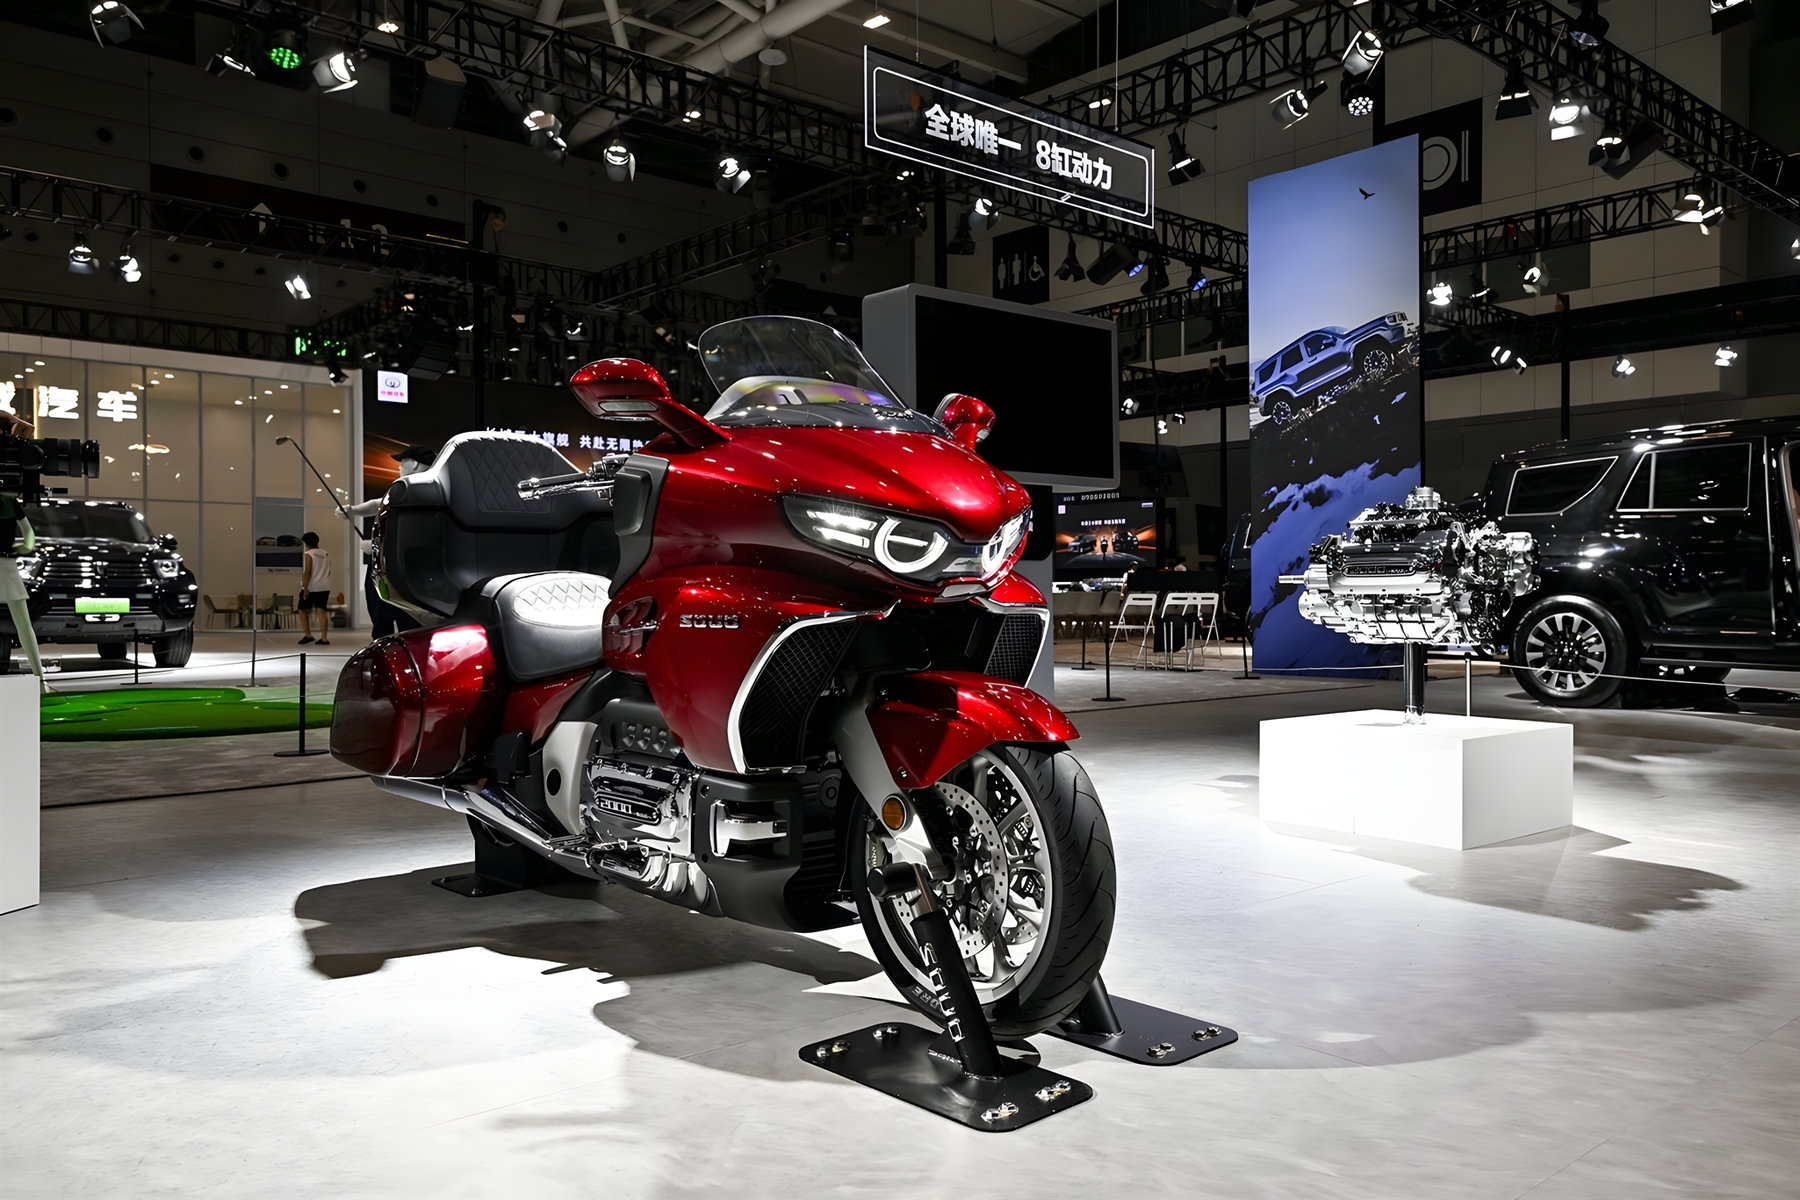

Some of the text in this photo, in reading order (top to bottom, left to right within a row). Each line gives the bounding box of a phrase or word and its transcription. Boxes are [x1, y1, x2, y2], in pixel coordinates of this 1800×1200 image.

[924, 103, 1113, 190] 全球唯一 8缸动力
[679, 614, 739, 629] SOUO
[600, 799, 632, 815] 2000
